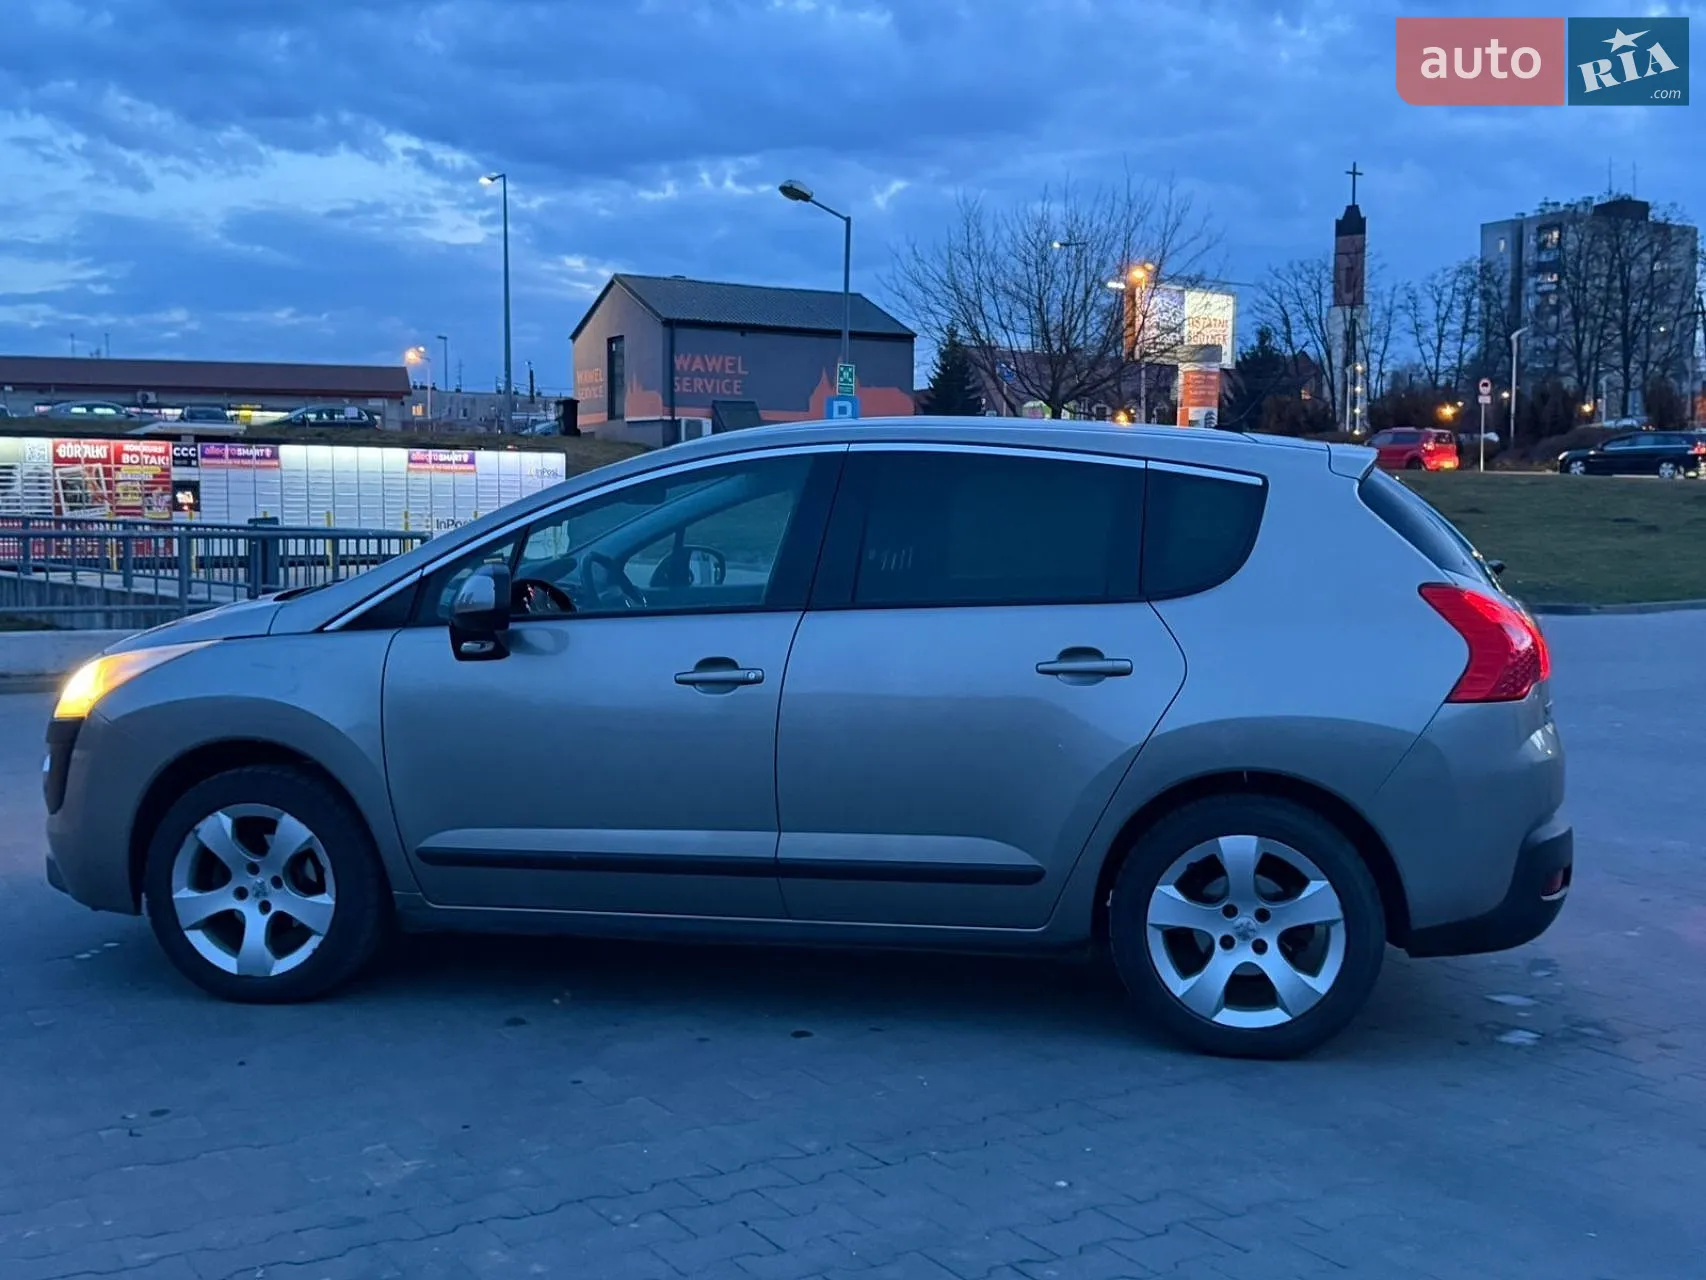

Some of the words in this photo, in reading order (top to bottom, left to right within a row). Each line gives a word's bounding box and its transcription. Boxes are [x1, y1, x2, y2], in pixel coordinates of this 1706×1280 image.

[674, 353, 748, 375] WAWEL
[674, 376, 743, 395] SERVICE
[173, 447, 197, 457] CCC
[122, 454, 140, 465] BO
[436, 519, 471, 529] InPo
